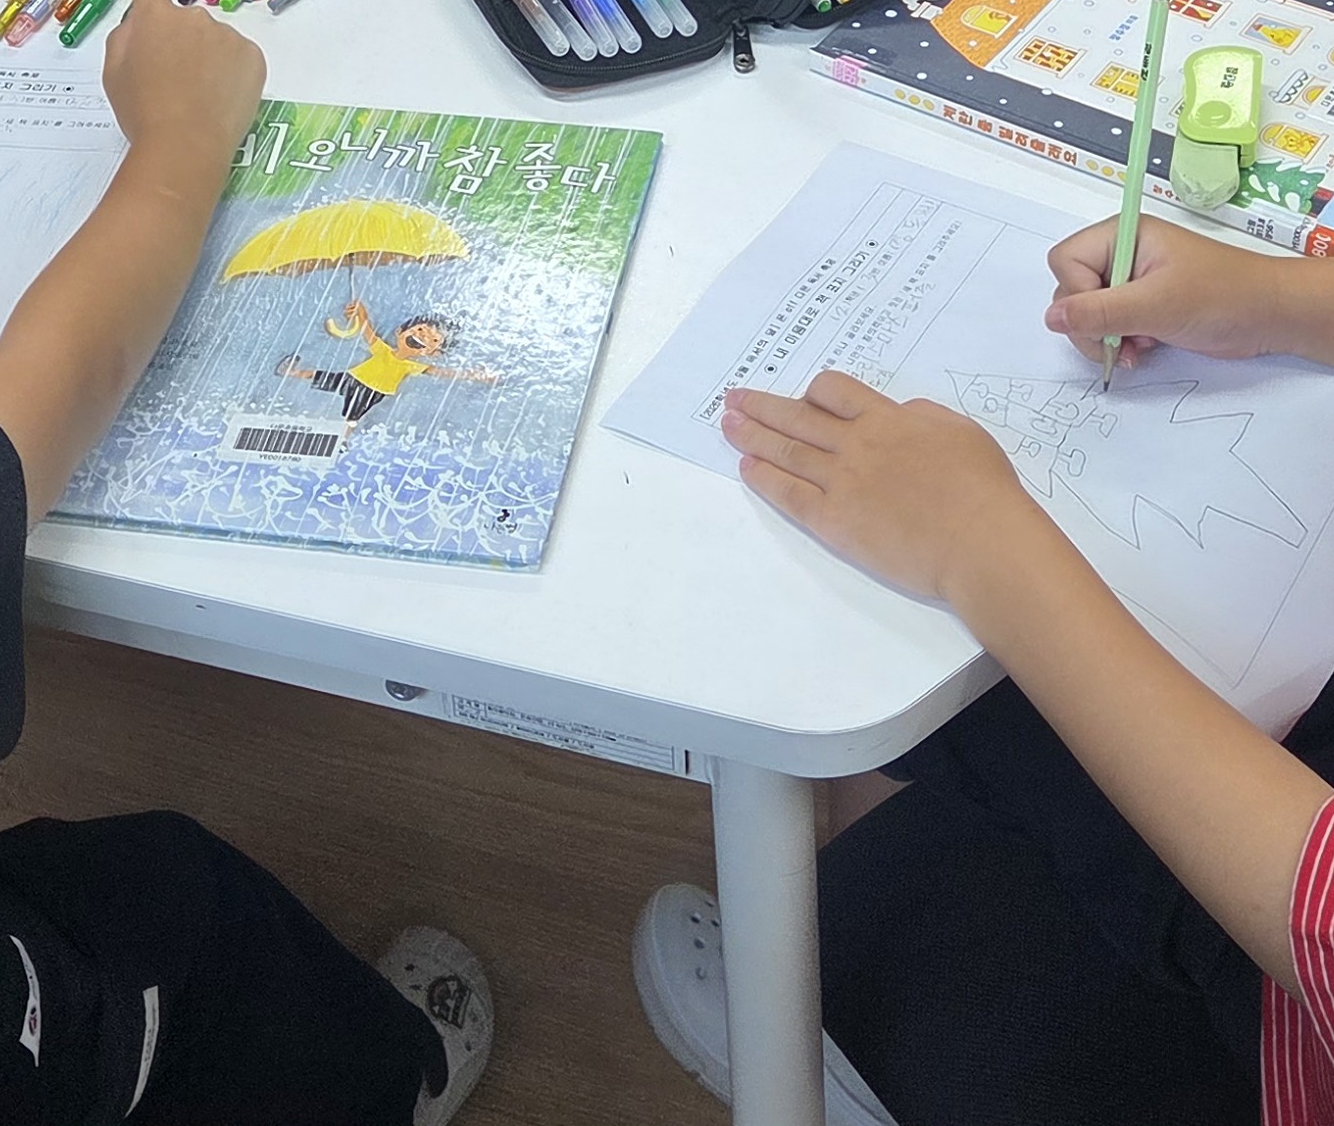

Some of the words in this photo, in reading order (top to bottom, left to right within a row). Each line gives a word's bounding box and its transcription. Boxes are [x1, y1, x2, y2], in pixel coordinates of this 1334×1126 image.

[18, 82, 57, 93] 그리기
[230, 122, 290, 175] 비
[289, 127, 444, 172] 오니까
[443, 144, 508, 195] 참
[515, 140, 617, 195] 좋다
[942, 104, 973, 126] 계란
[998, 125, 1078, 166] 빌려줄래요
[773, 346, 790, 360] 내
[784, 306, 821, 345] 마음대로
[814, 293, 832, 305] 책
[825, 276, 847, 294] 표지
[841, 250, 871, 276] 그리기
